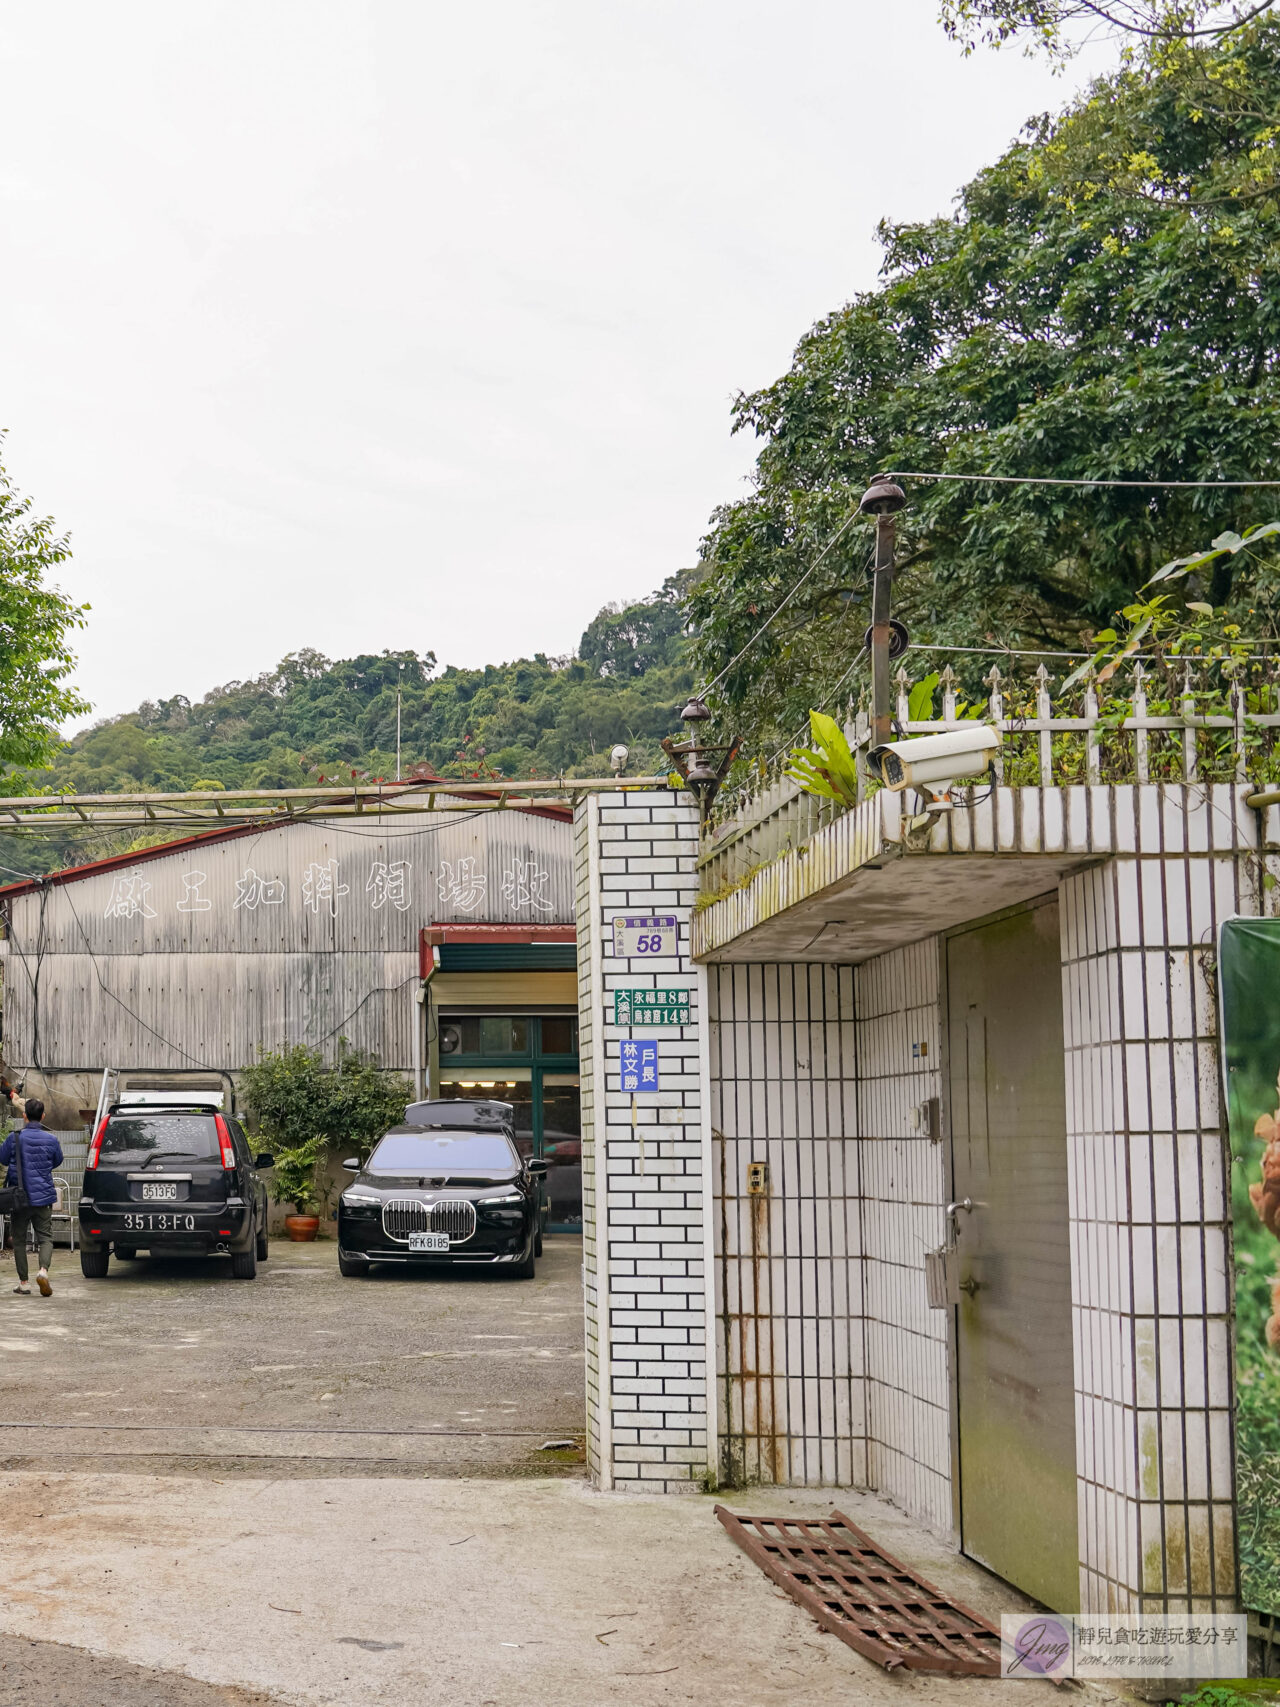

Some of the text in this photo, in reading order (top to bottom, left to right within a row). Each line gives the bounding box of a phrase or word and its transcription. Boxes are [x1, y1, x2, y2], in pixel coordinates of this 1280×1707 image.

[636, 934, 662, 953] 58
[617, 990, 631, 1025] 大溪鎮
[634, 991, 688, 1005] 永福里8鄰
[623, 1042, 639, 1090] 林文勝
[124, 1214, 195, 1231] 3513-FQ
